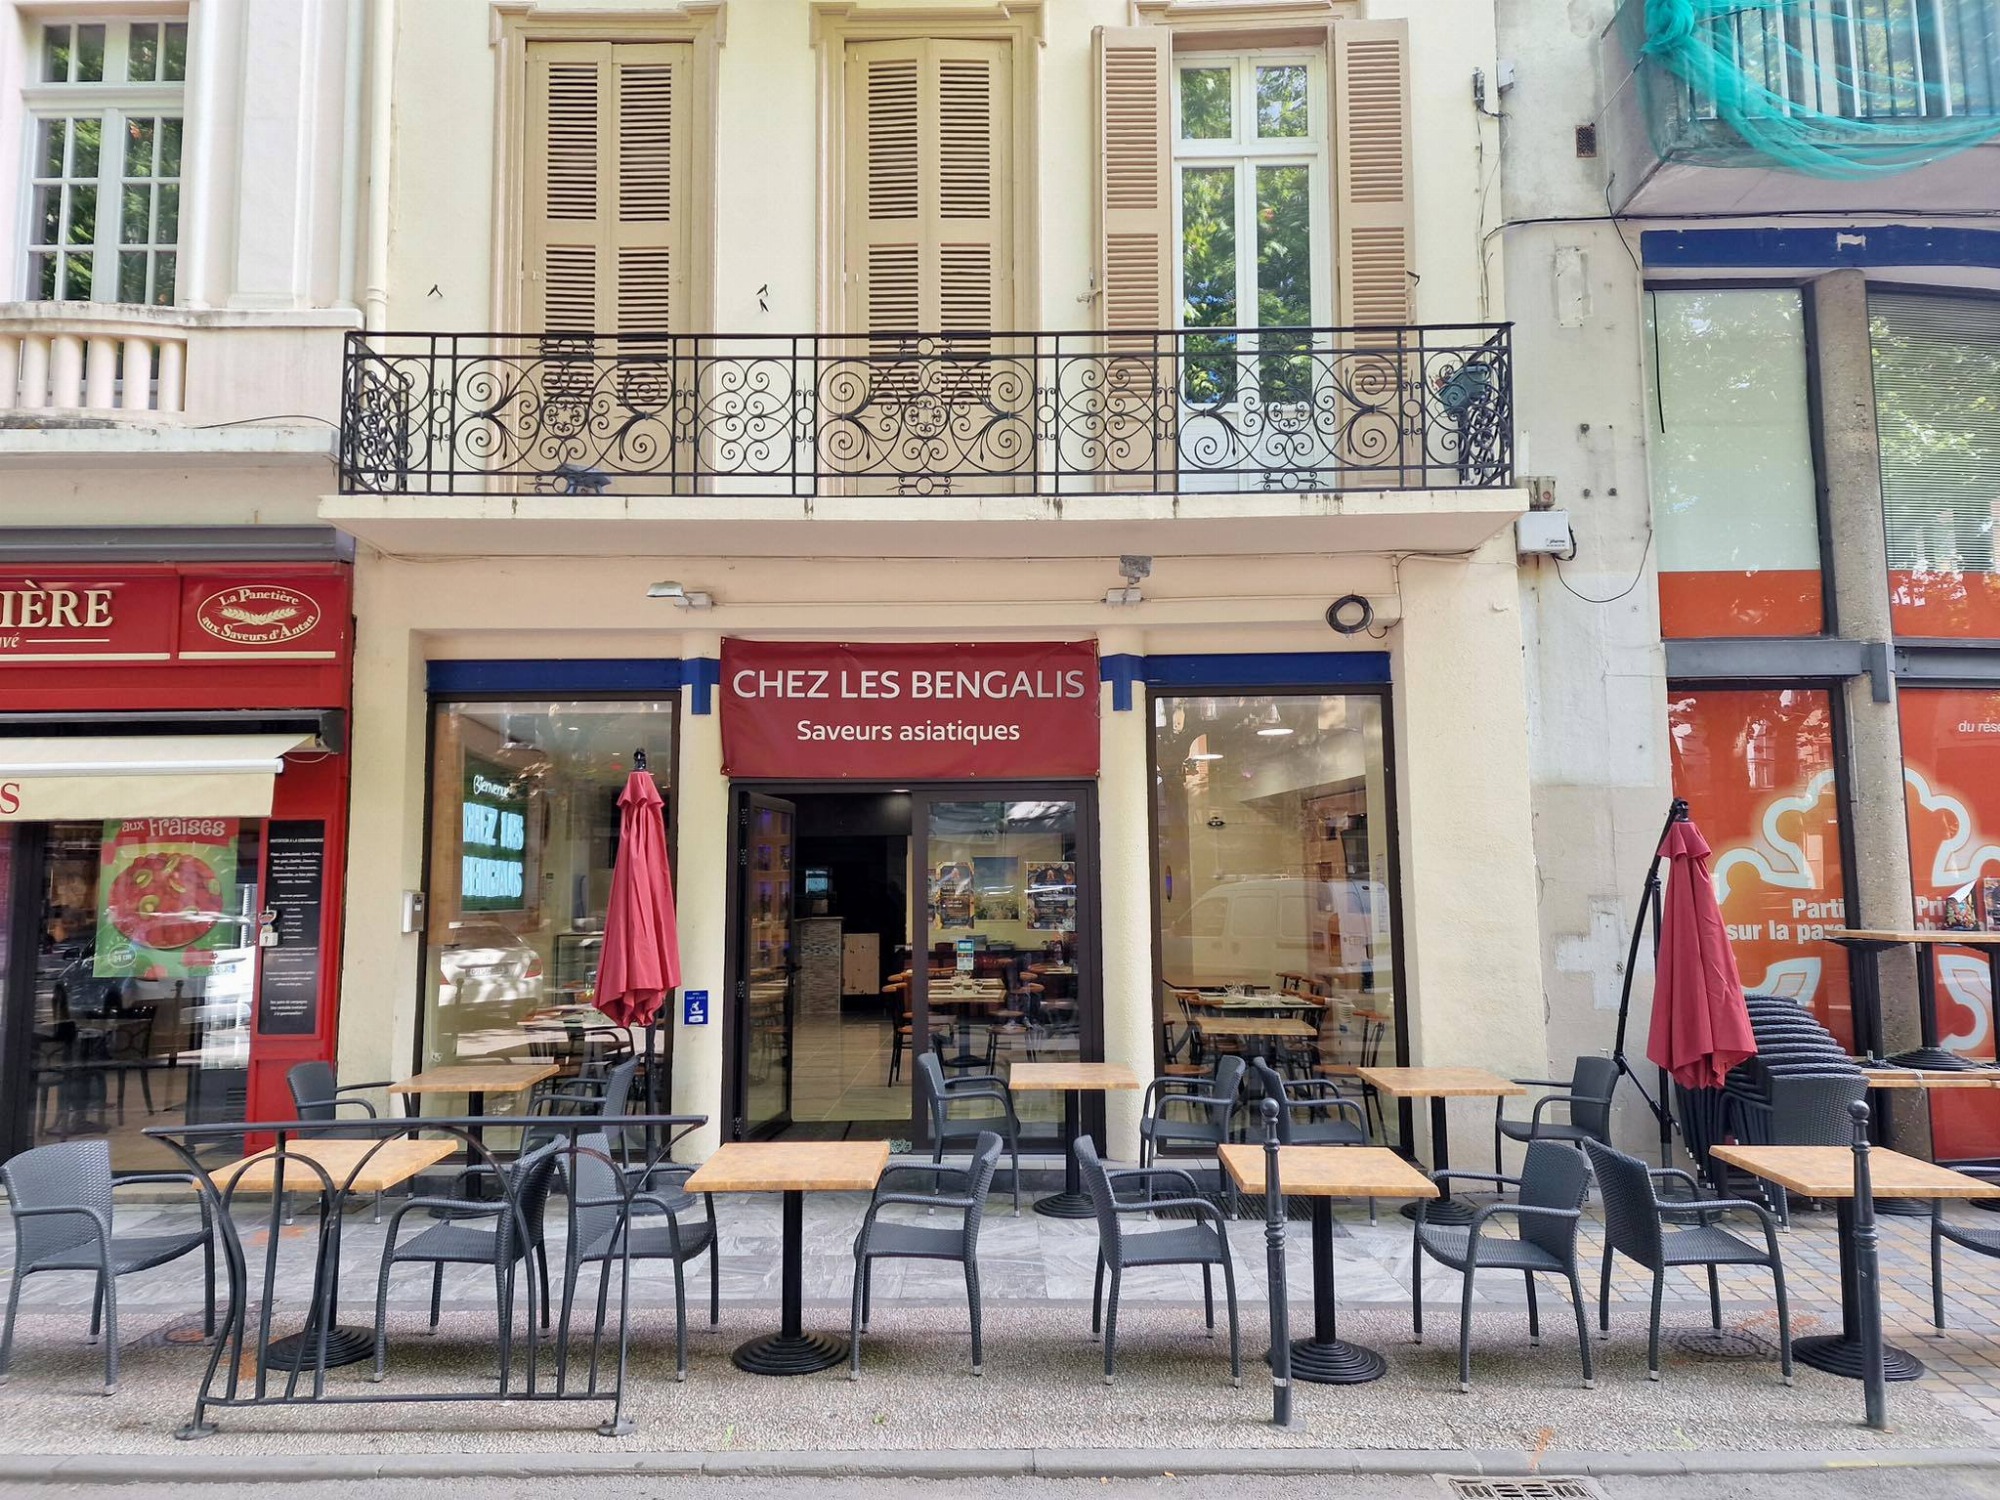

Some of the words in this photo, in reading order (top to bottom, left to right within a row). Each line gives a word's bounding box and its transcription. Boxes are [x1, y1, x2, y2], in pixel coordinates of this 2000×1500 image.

[219, 595, 237, 606] La
[238, 588, 299, 605] Panetière
[202, 616, 220, 634] aux
[221, 624, 267, 641] Saveurs
[269, 615, 315, 640] d'Antan
[0, 632, 20, 648] vé
[733, 669, 830, 699] CHEZ
[841, 670, 901, 699] LES
[911, 670, 1085, 699] BENGALIS
[797, 719, 893, 741] Saveurs
[899, 719, 1020, 746] asiatiques
[1958, 720, 1975, 732] du
[122, 821, 144, 832] aux
[1726, 923, 1762, 941] sur
[1768, 920, 1789, 941] la
